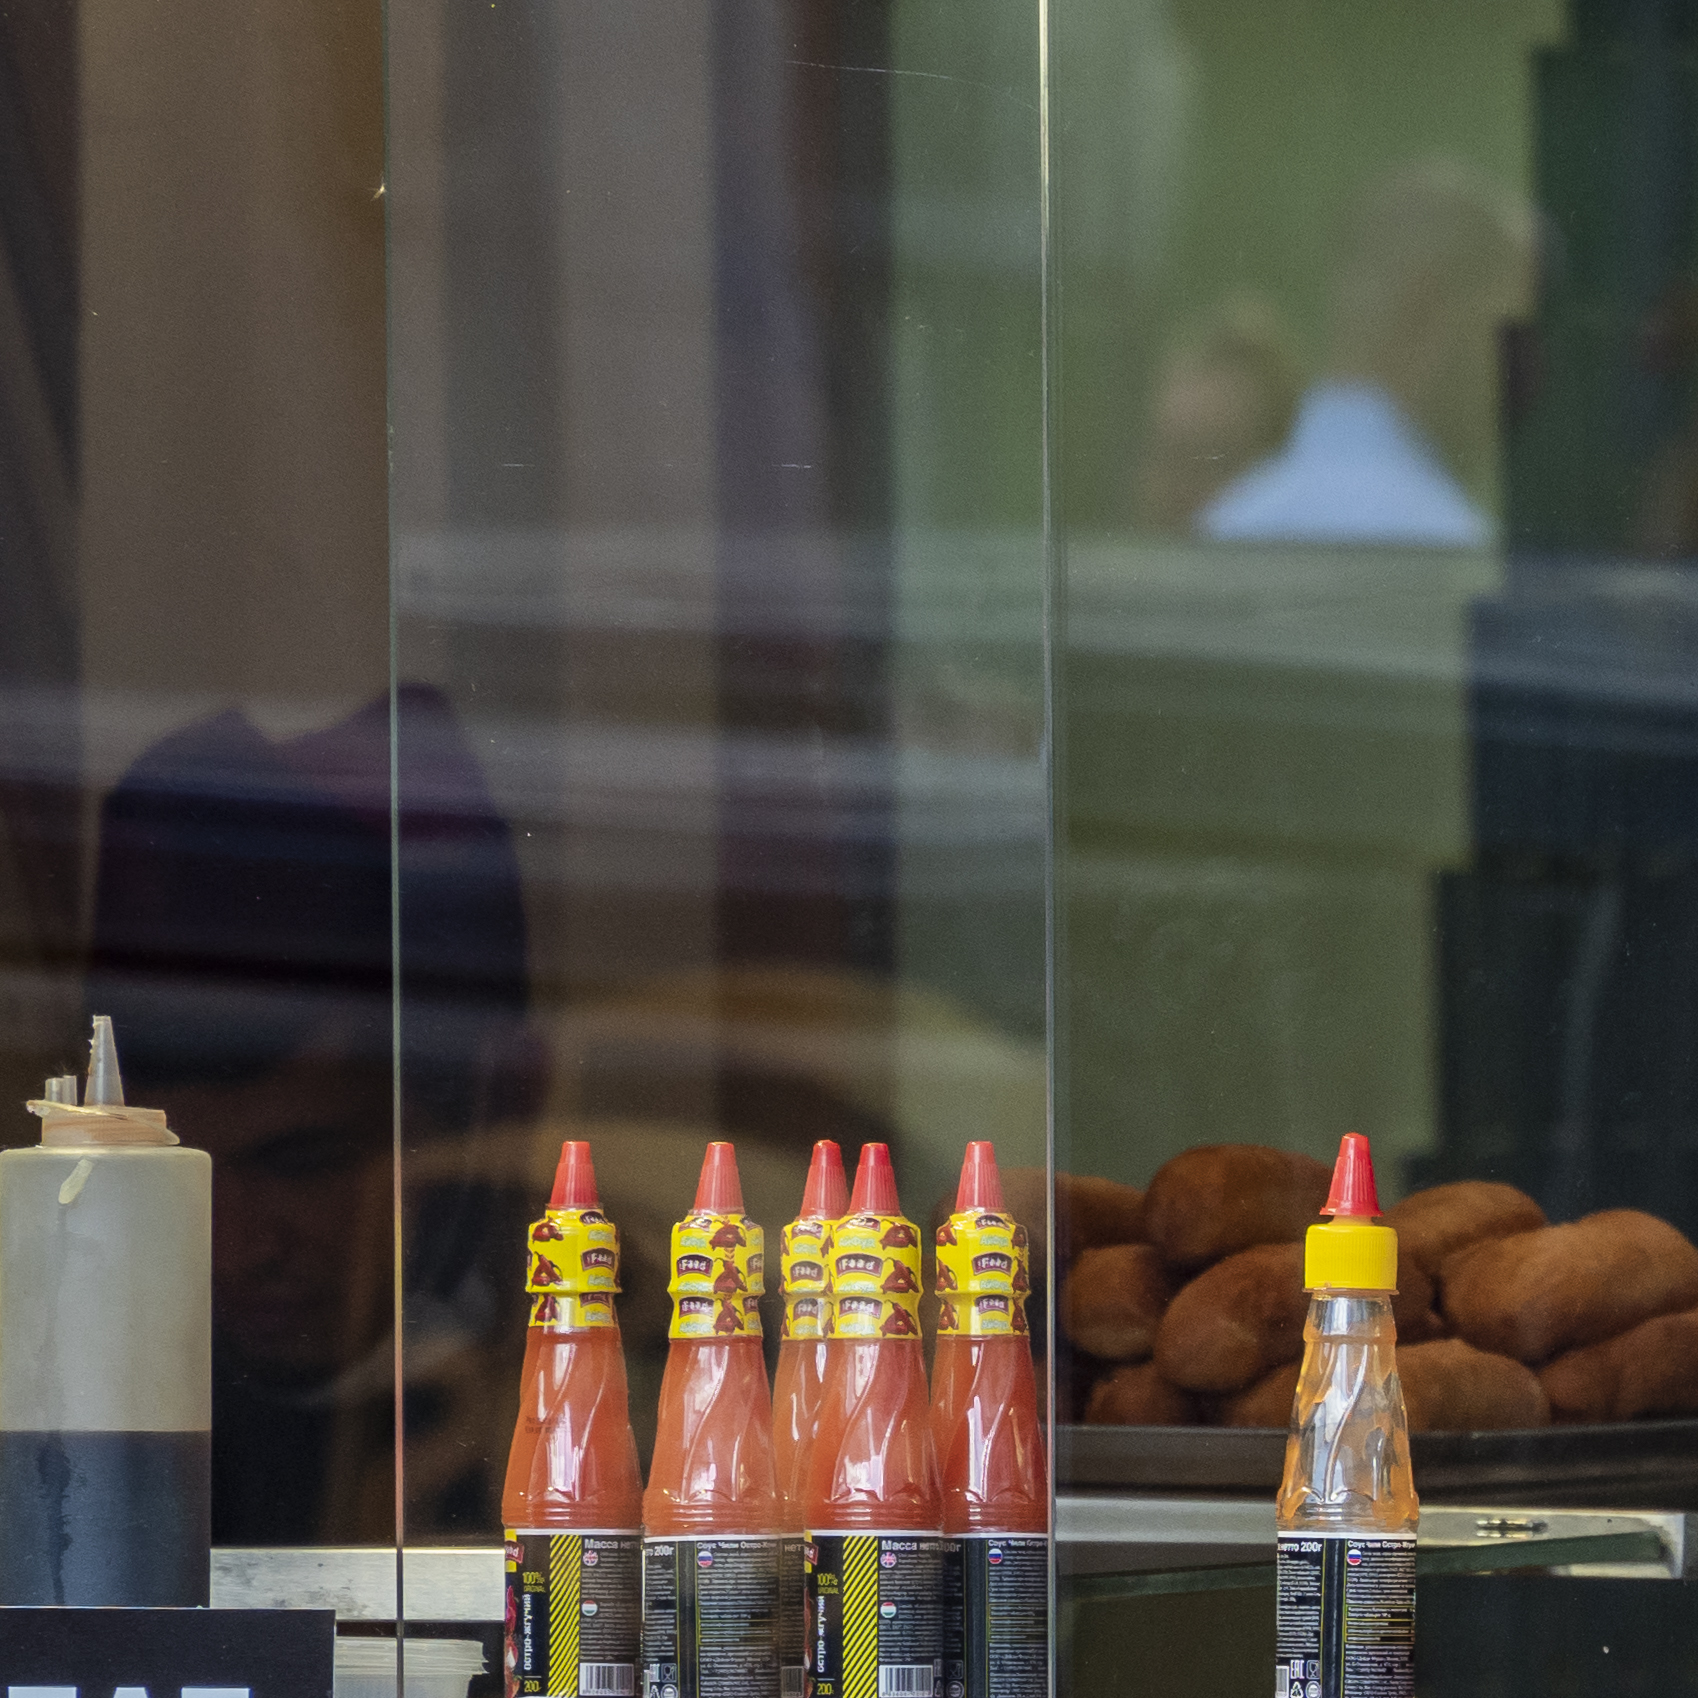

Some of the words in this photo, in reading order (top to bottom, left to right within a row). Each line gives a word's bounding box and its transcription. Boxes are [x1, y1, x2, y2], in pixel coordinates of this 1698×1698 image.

[584, 1538, 619, 1549] Масса
[881, 1540, 918, 1551] Масса
[1301, 1541, 1322, 1553] 200г
